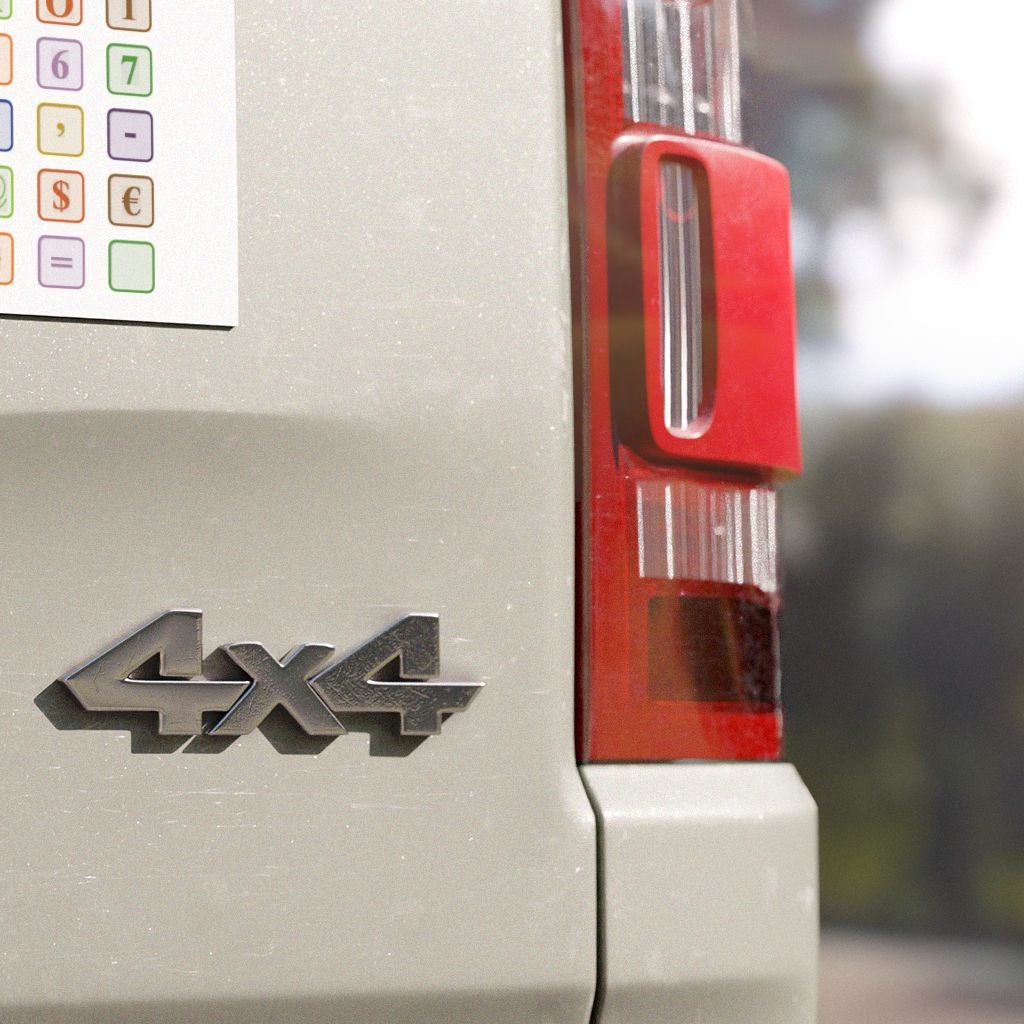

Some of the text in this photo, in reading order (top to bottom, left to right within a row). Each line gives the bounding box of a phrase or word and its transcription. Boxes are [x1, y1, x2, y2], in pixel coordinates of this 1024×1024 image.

[51, 50, 69, 79] 6
[121, 55, 138, 85] 7
[52, 180, 70, 212] $
[122, 186, 140, 216] €
[51, 256, 73, 269] =
[63, 608, 485, 736] 4x4
